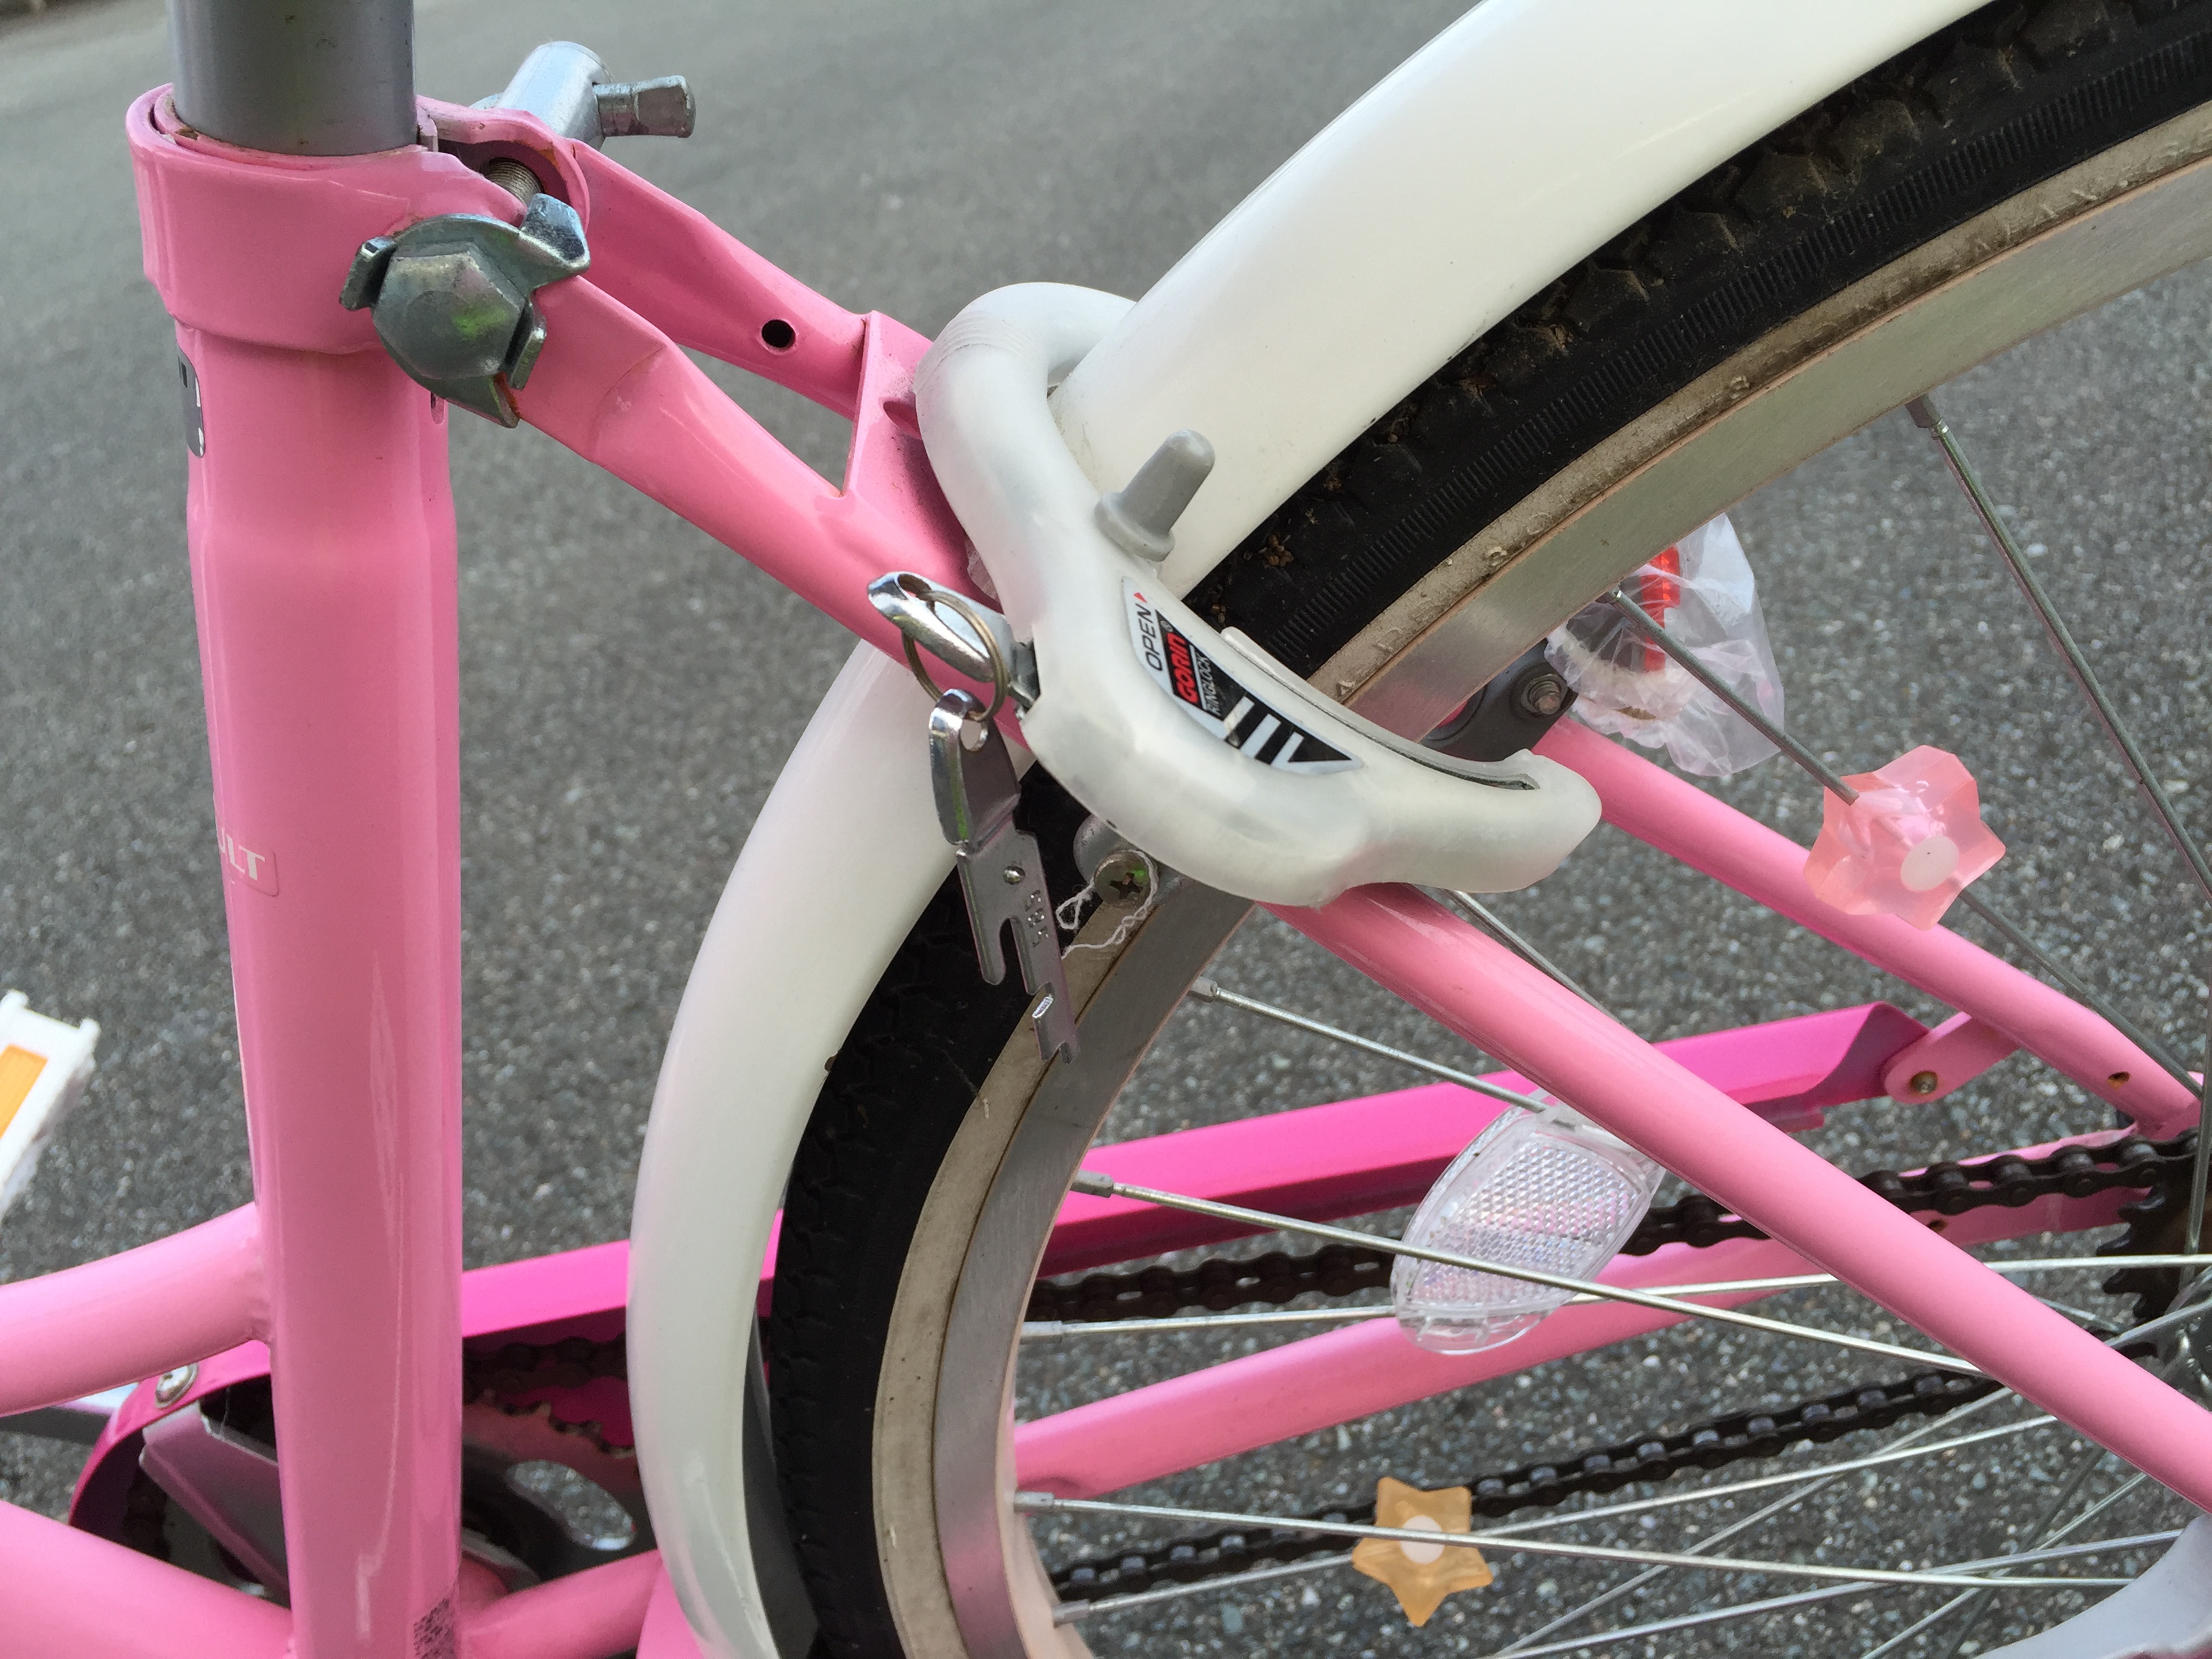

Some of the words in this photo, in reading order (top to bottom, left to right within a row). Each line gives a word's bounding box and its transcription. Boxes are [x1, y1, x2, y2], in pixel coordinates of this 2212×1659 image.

[1134, 602, 1163, 672] OPEN
[1166, 632, 1199, 704] GORIN
[1195, 651, 1223, 716] RINGLOCK
